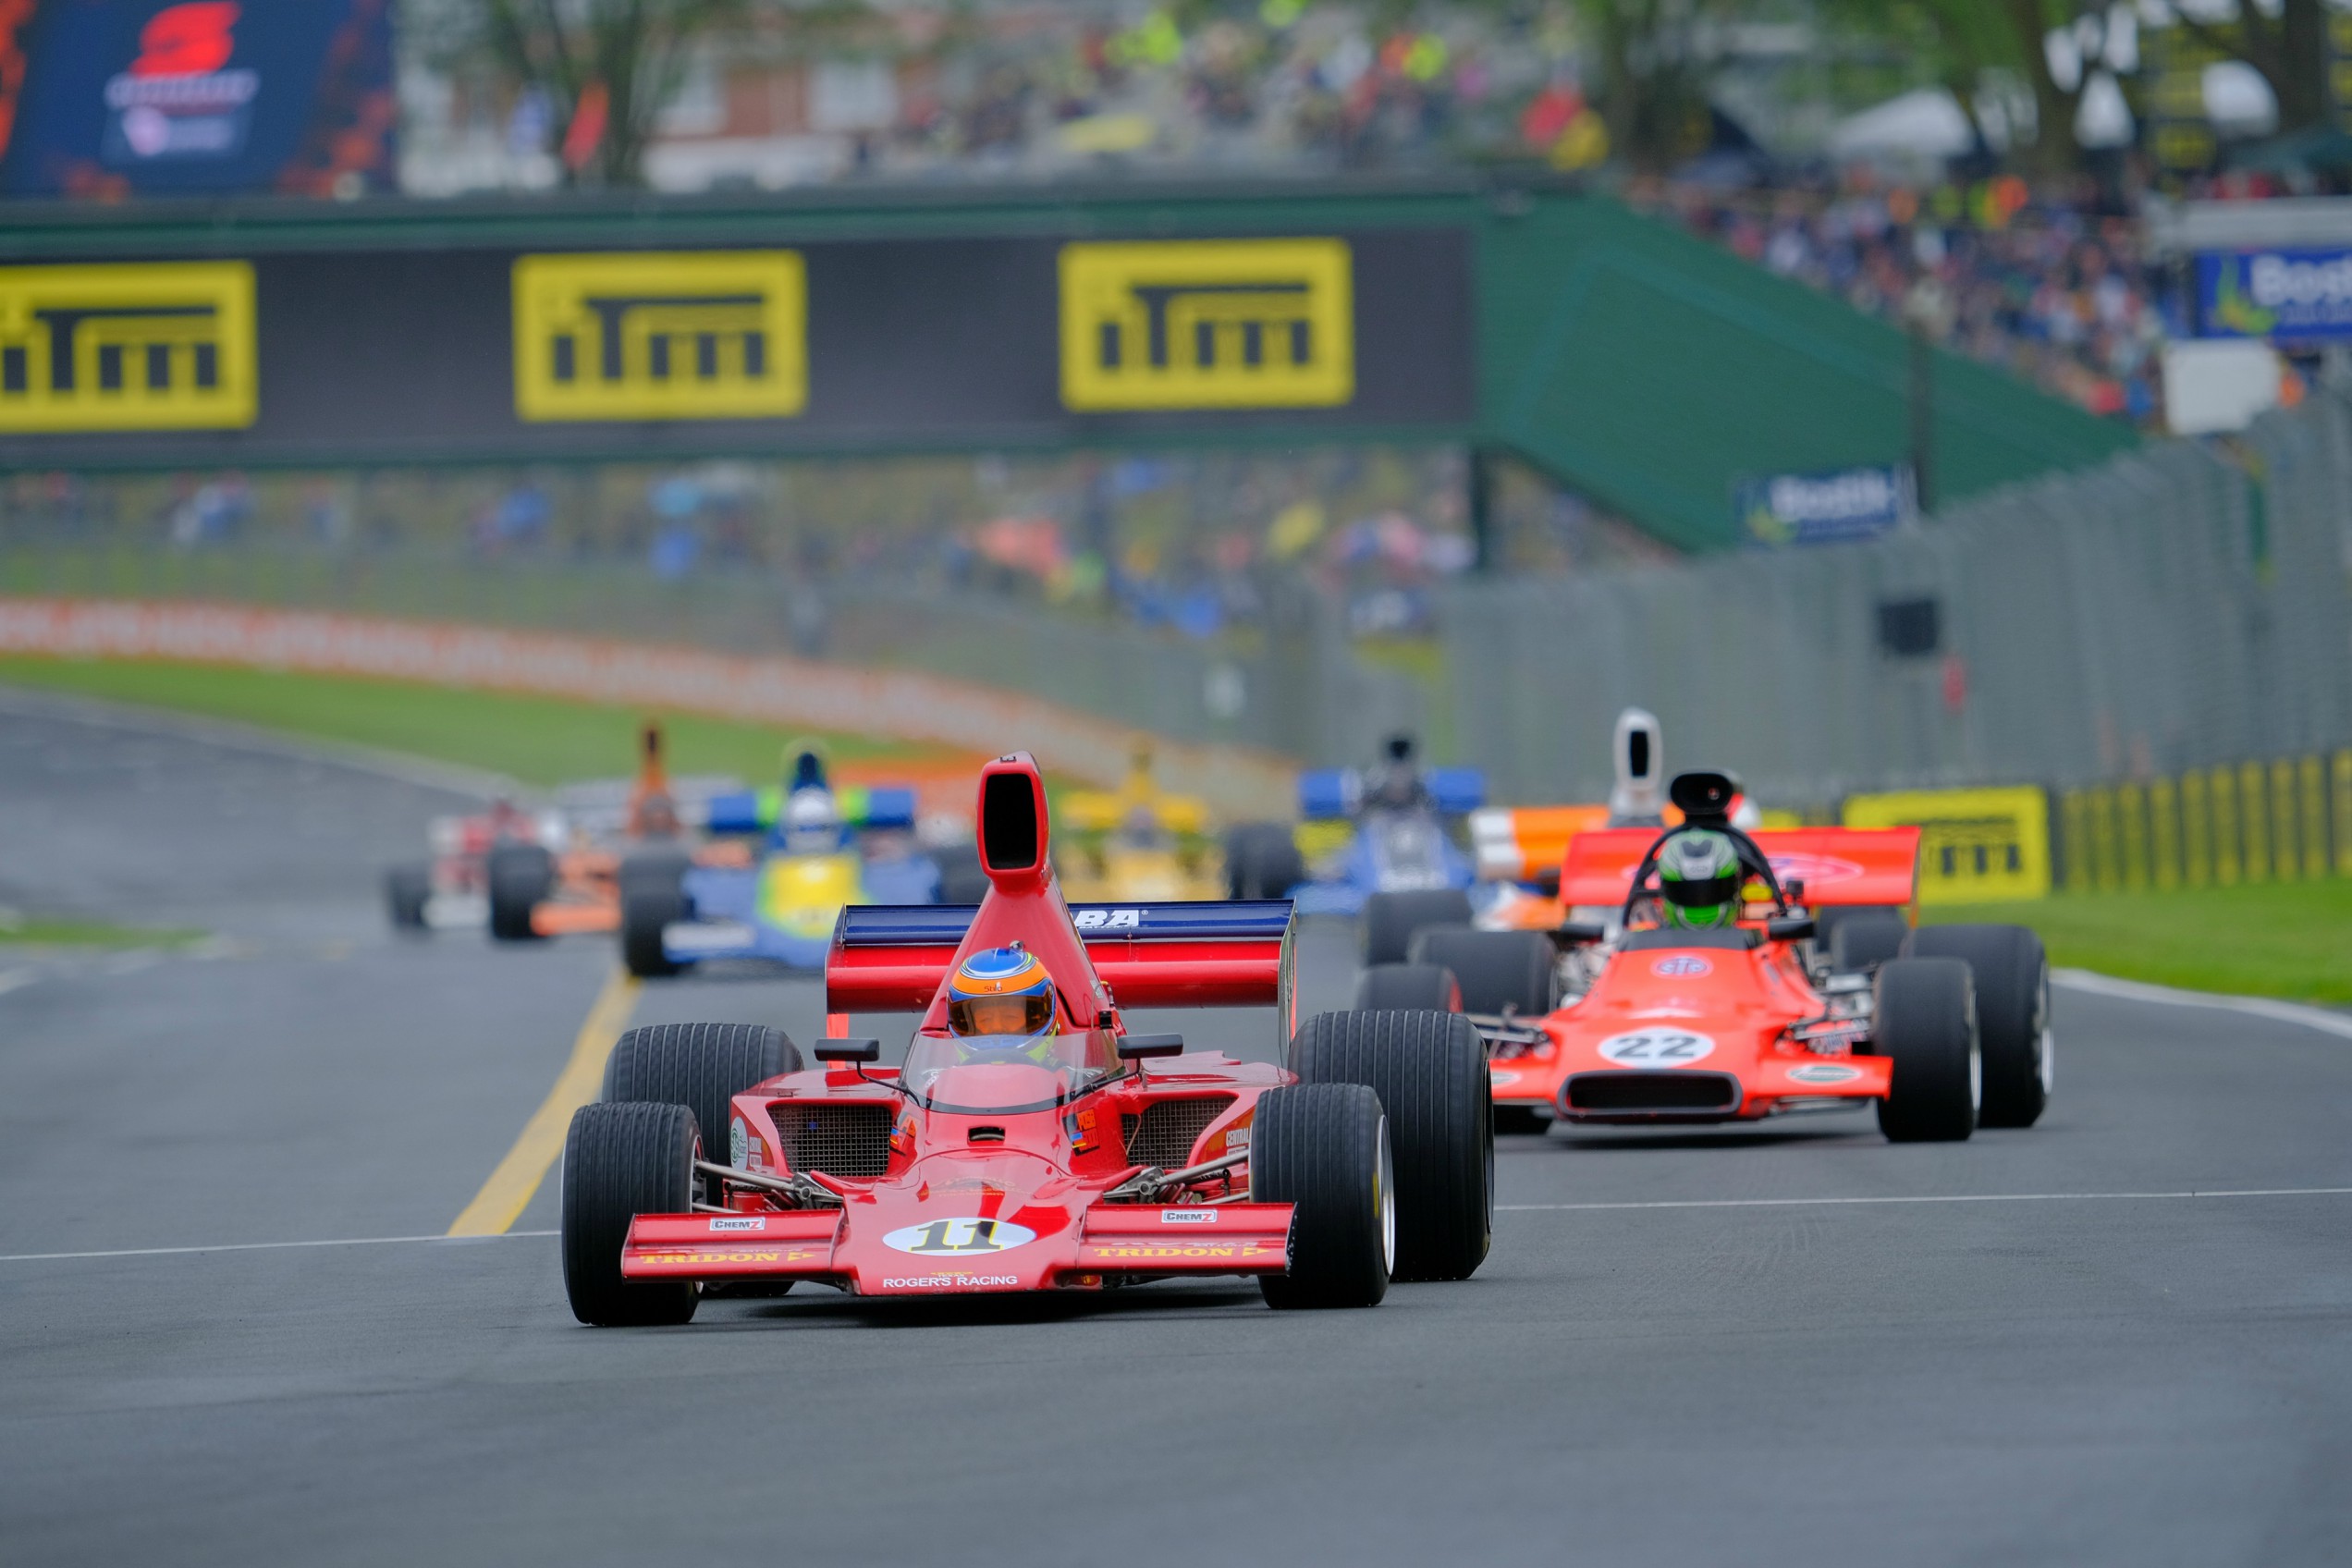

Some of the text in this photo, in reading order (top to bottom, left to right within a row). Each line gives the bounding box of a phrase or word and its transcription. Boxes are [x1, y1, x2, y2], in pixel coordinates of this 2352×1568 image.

[1072, 910, 1139, 926] BA
[1614, 1035, 1697, 1059] 22
[910, 1219, 1004, 1252] 11
[640, 1252, 778, 1264] TRIDON
[1094, 1247, 1233, 1257] TRIDON
[883, 1275, 1018, 1288] ROGER'S RACING
